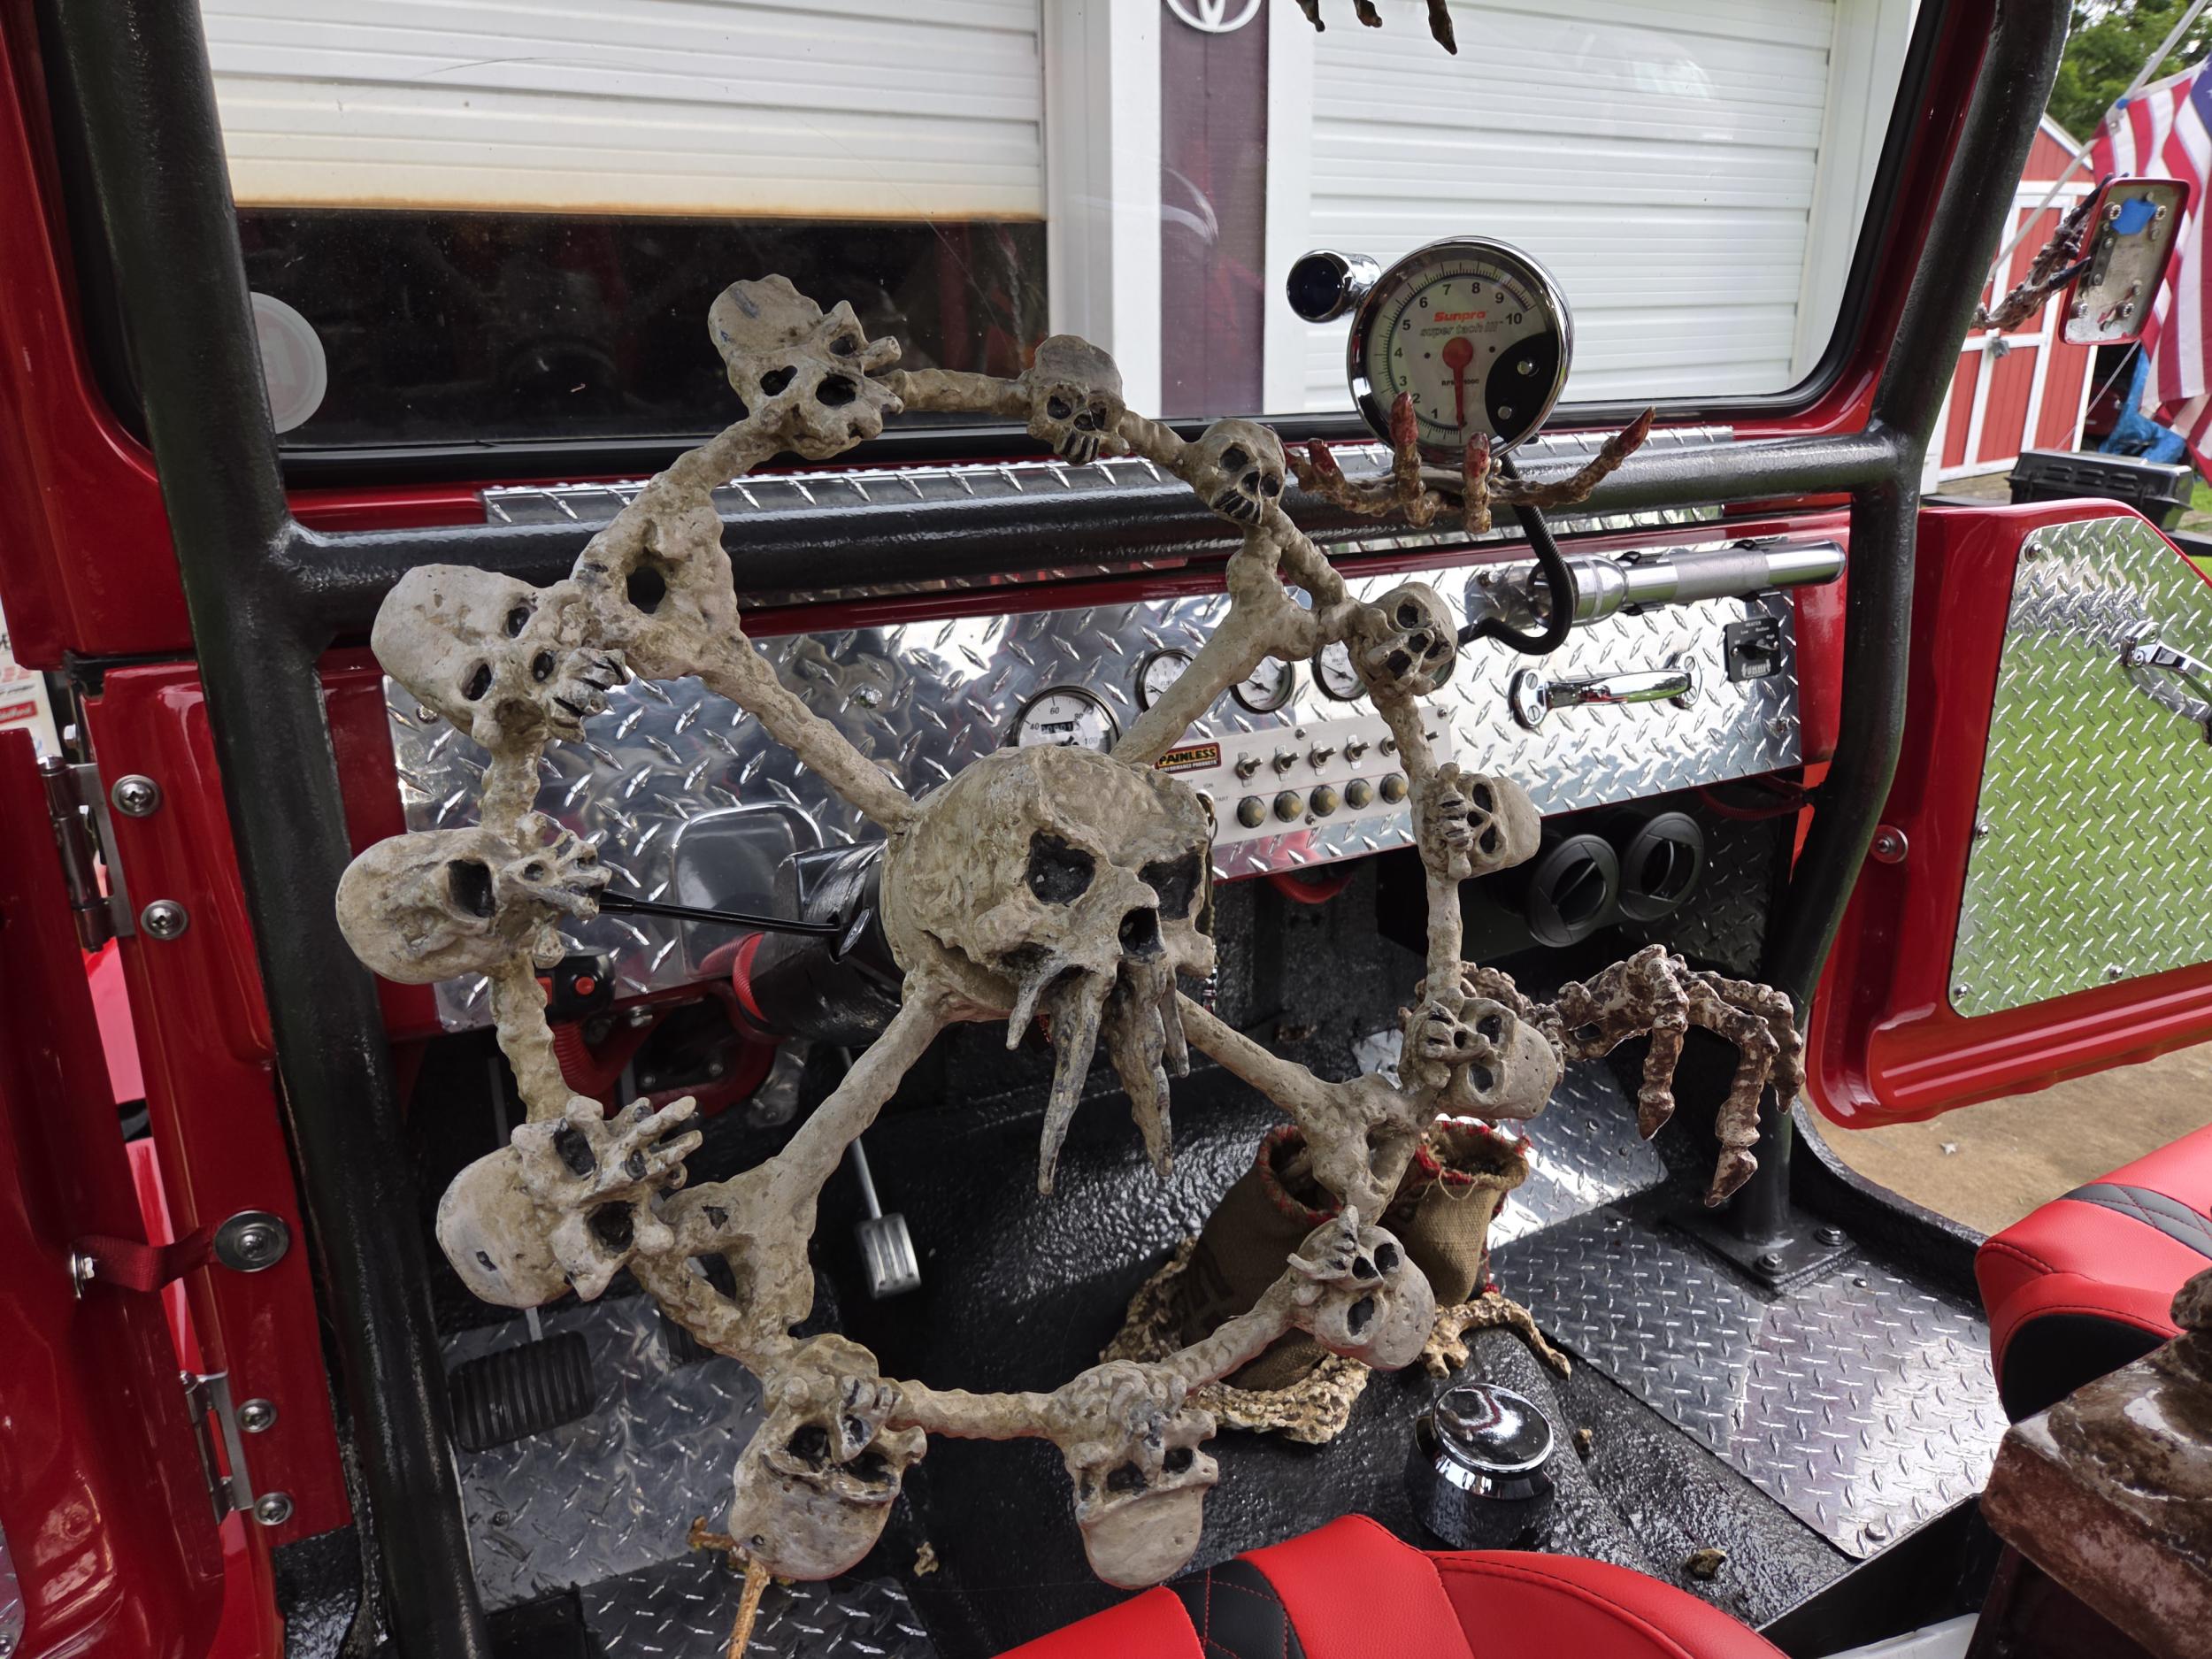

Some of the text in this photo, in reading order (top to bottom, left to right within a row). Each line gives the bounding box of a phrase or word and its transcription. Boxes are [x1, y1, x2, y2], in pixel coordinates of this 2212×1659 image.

[1442, 284, 1451, 295] 7
[1471, 282, 1480, 294] 8
[1419, 296, 1428, 308] 6
[1495, 292, 1504, 303] 9
[1506, 312, 1523, 325] 10
[1402, 319, 1411, 330] 5
[1394, 347, 1403, 357] 4
[1399, 375, 1408, 387] 3
[1413, 393, 1421, 403] 2
[1431, 408, 1439, 419] 1
[1049, 706, 1060, 715] 60
[1030, 722, 1040, 731] 40
[1159, 749, 1215, 764] PAINLESS
